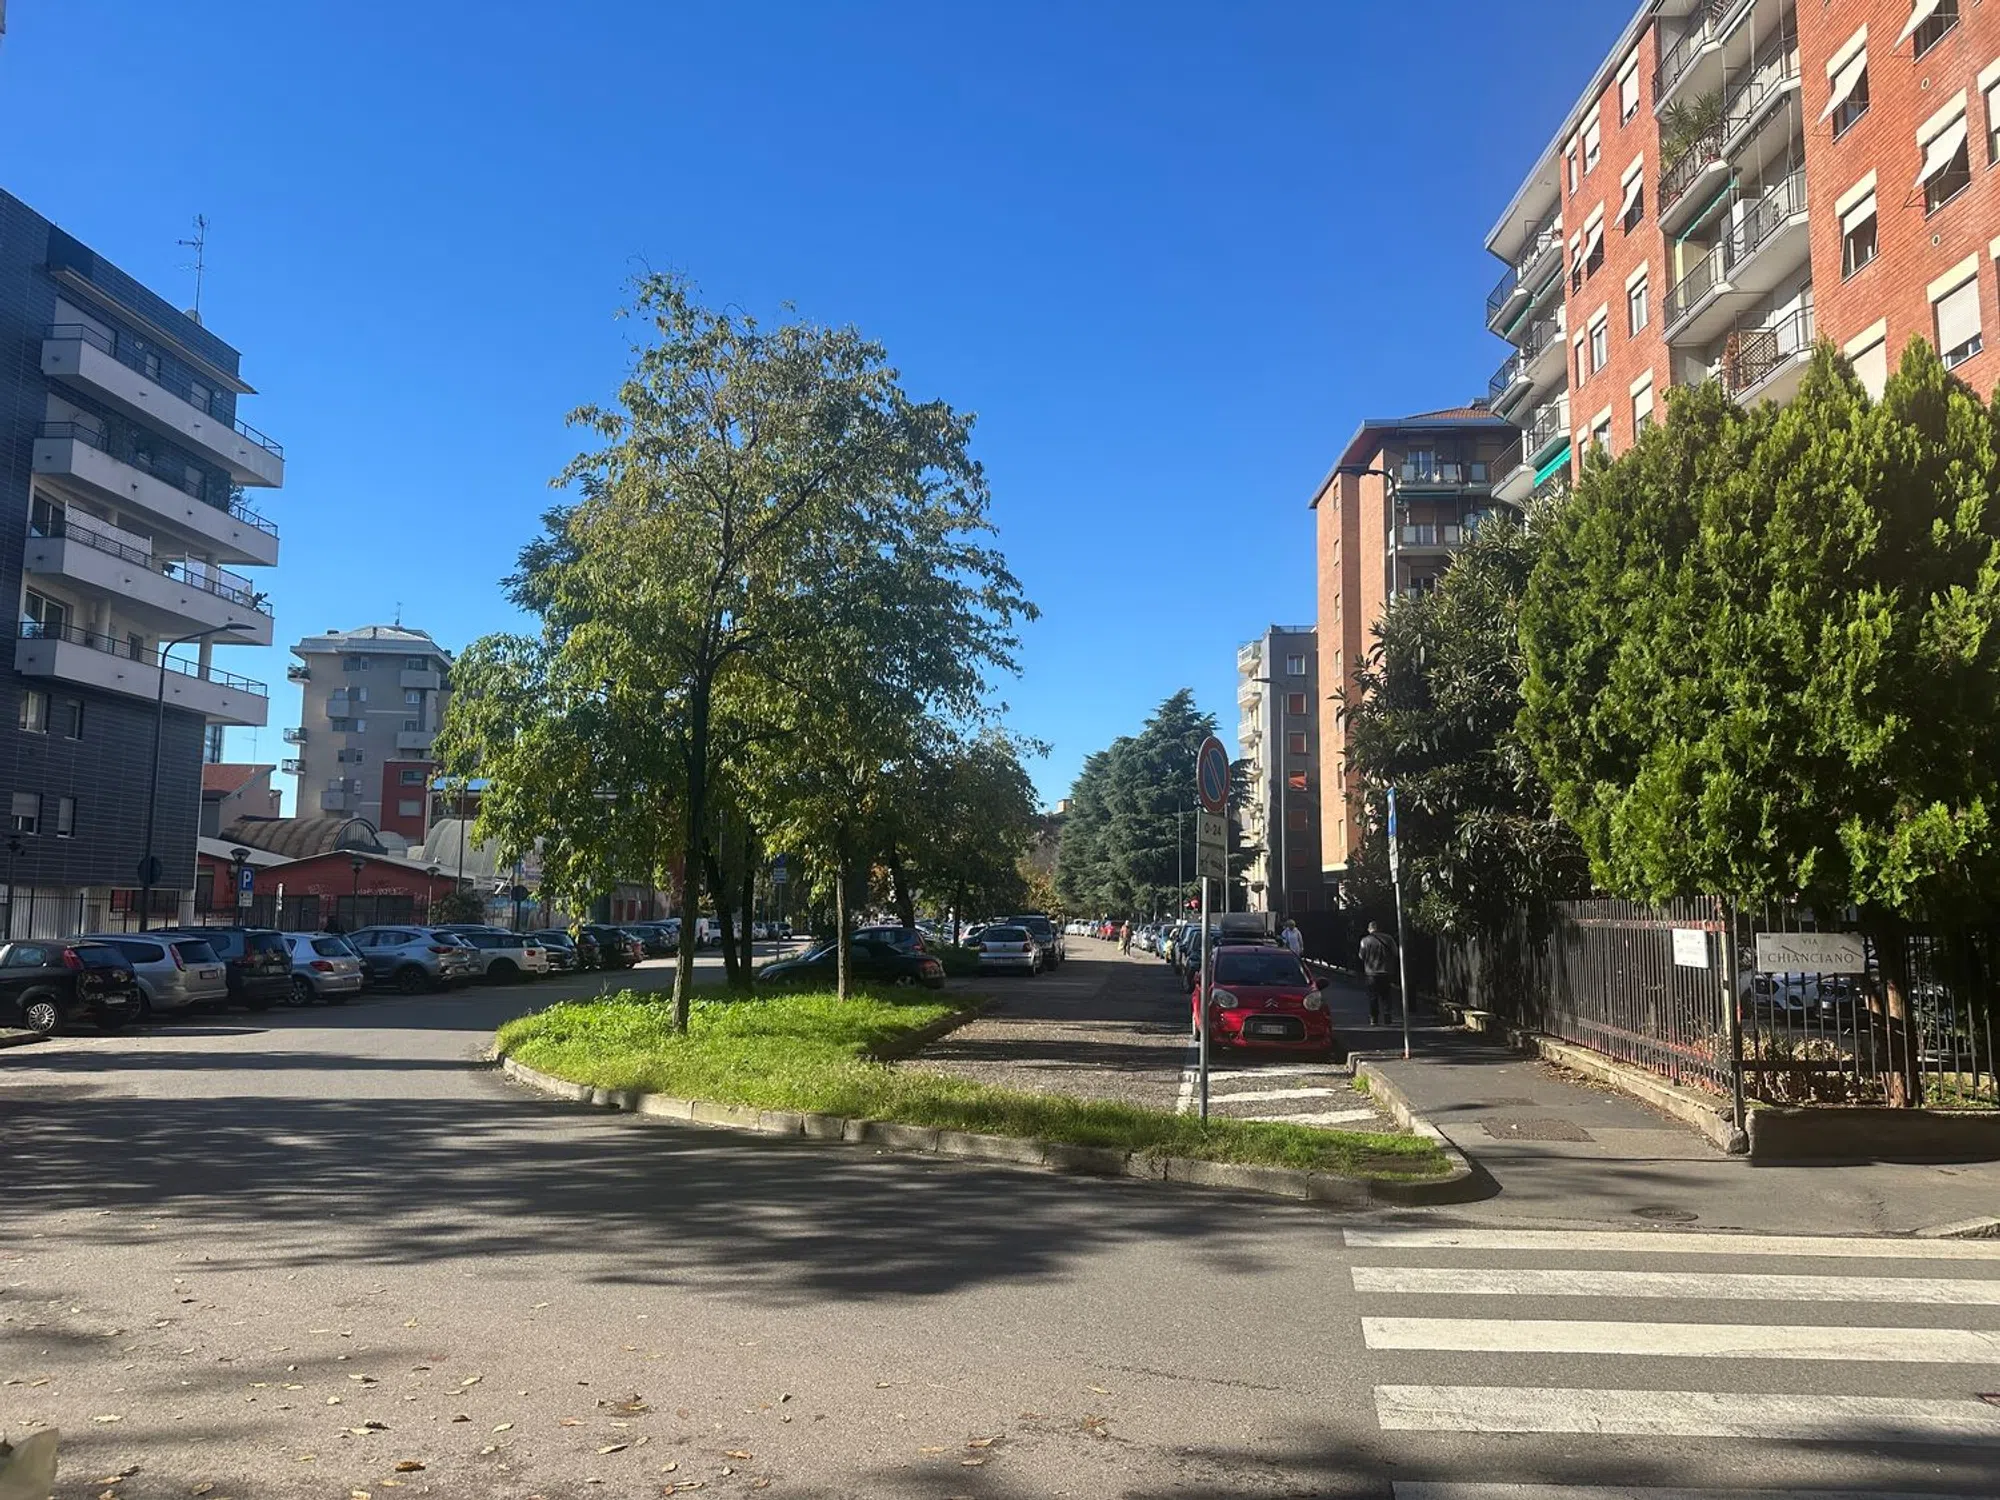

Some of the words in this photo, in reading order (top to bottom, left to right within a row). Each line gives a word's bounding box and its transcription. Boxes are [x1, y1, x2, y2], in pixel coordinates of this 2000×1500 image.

[1204, 822, 1222, 836] 0-24
[243, 870, 252, 888] P
[1802, 938, 1818, 946] VIA
[1768, 953, 1855, 964] CHIANCIANO
